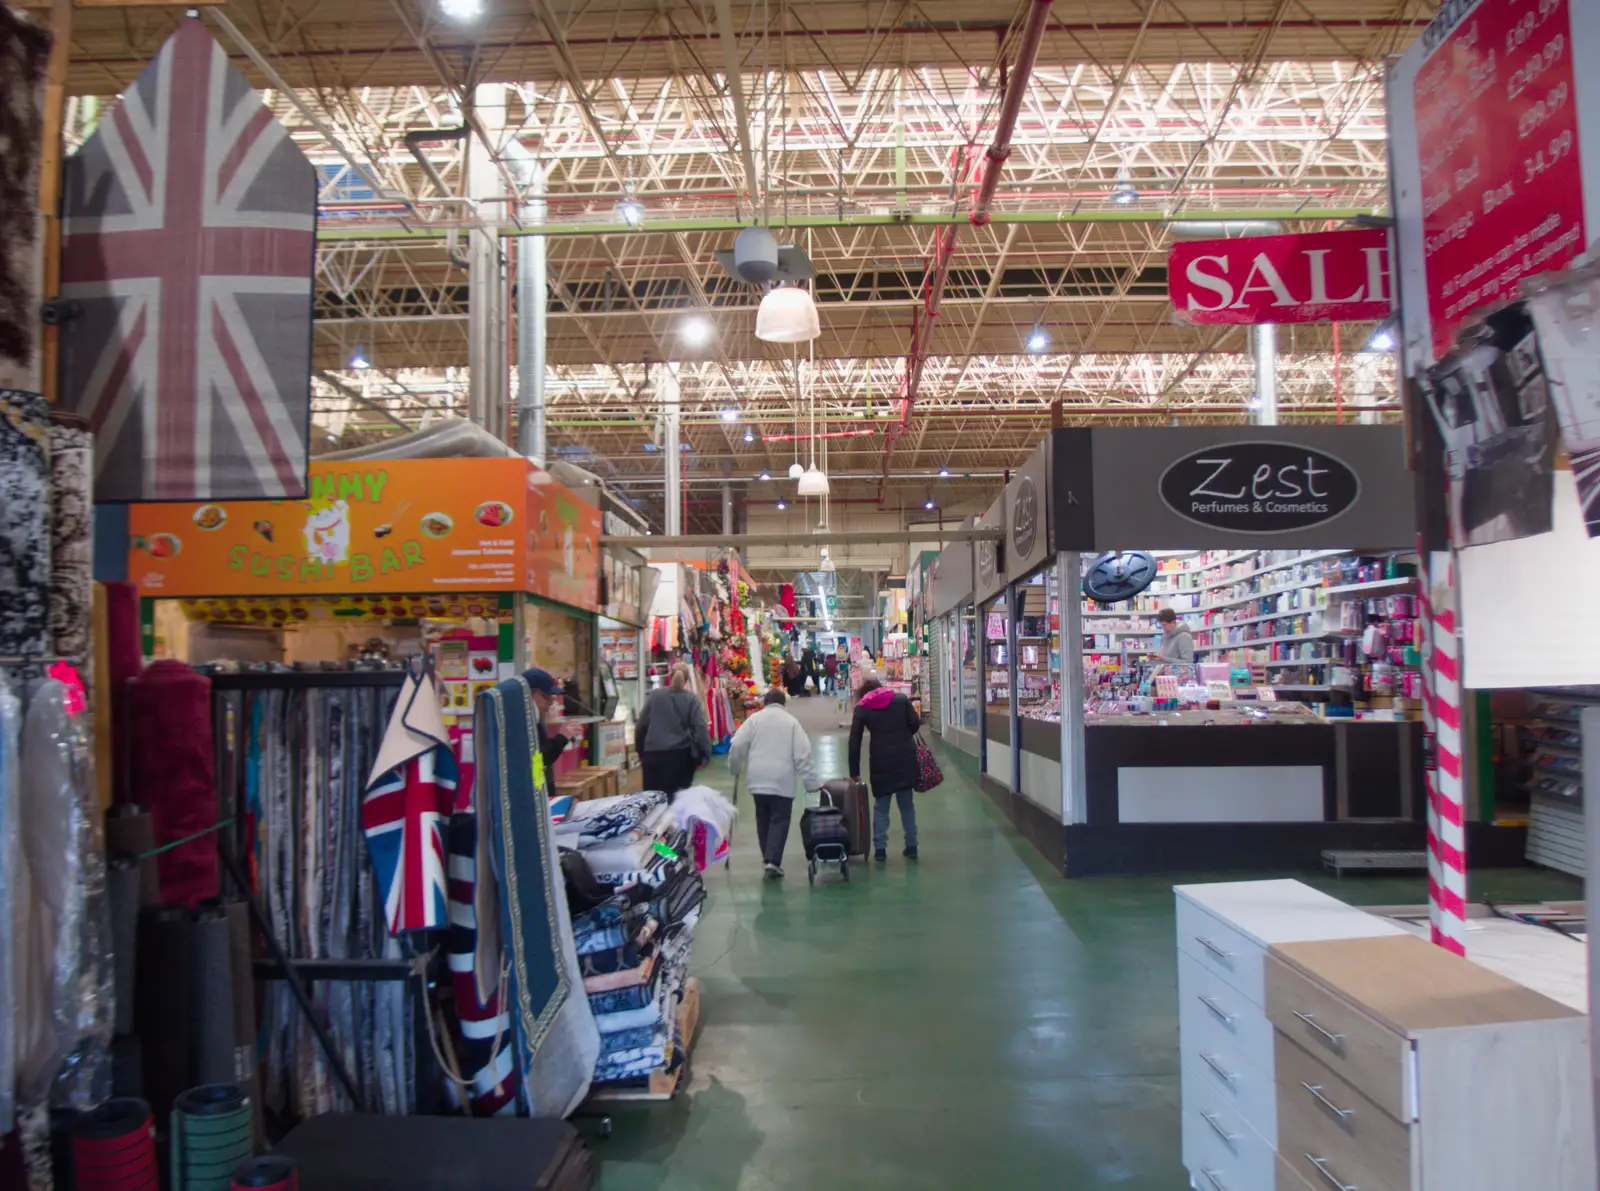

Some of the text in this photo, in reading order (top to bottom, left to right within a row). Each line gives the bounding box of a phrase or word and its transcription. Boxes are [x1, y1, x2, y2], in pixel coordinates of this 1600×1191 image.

[1424, 210, 1474, 258] Storage
[1482, 180, 1516, 215] Box
[1453, 256, 1494, 291] Furniture
[1527, 213, 1561, 243] made
[1480, 275, 1500, 297] any
[1499, 264, 1521, 285] size
[1189, 456, 1329, 500] Zest
[1191, 501, 1329, 514] Perfumes & Cosmetics
[227, 541, 426, 583] SUSHI BAR
